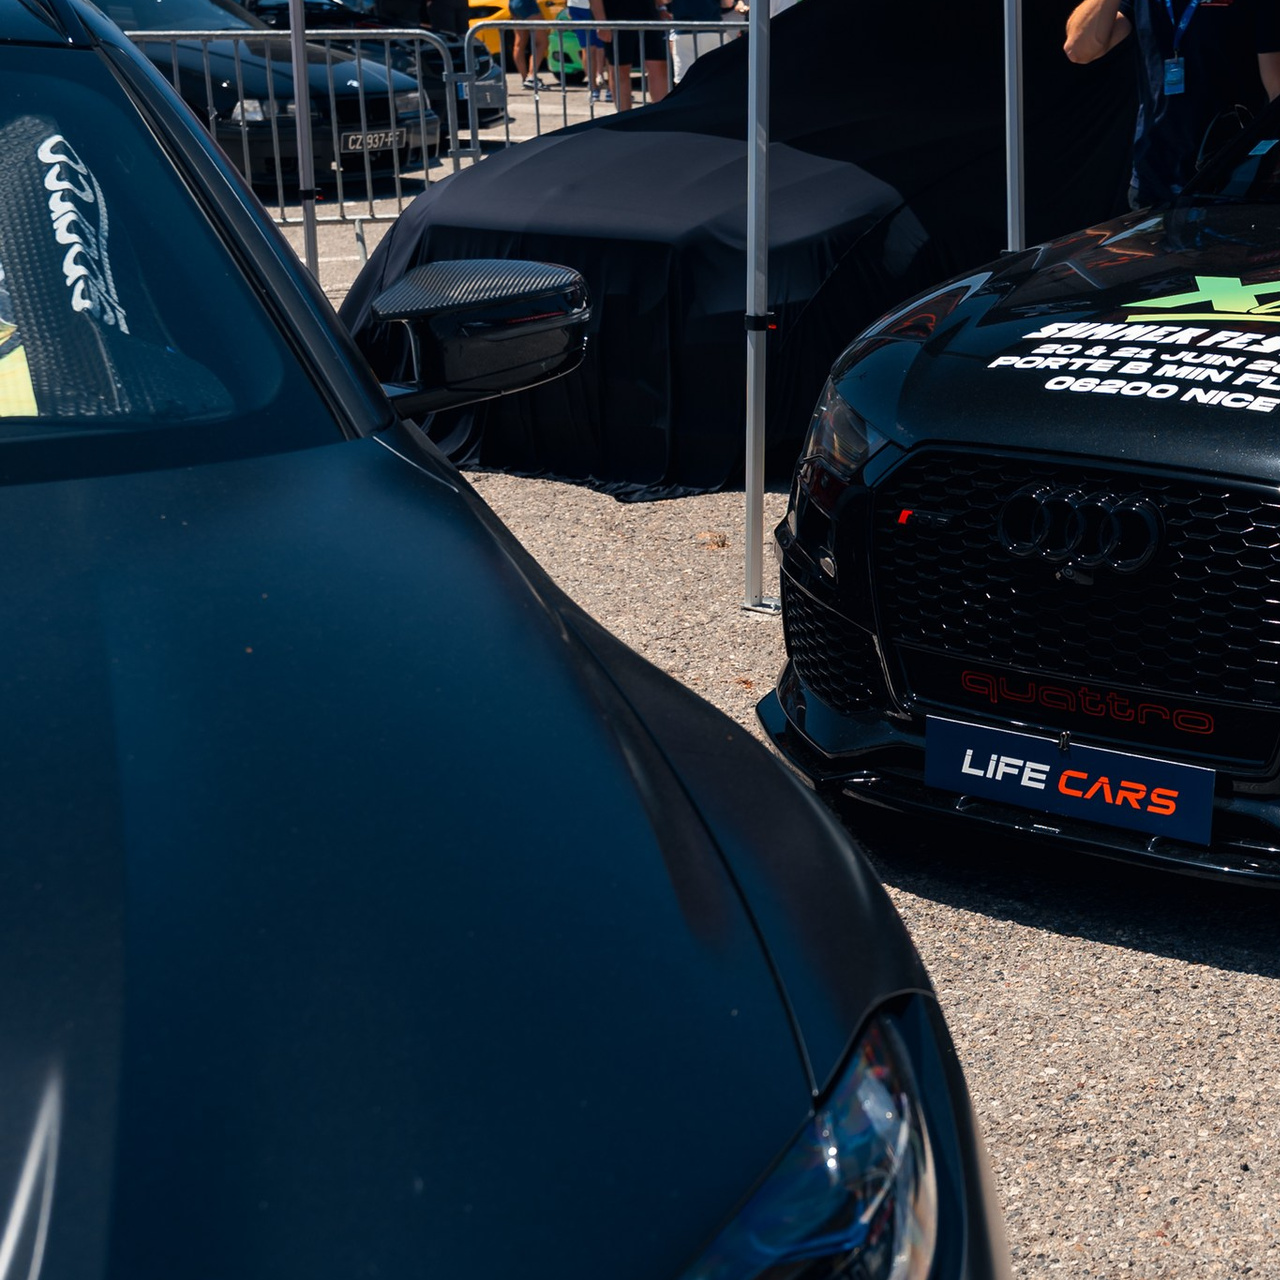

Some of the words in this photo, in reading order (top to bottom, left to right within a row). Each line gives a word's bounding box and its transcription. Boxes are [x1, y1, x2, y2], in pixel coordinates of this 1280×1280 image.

[1021, 322, 1201, 347] SUMMER
[1030, 343, 1078, 355] 20
[1110, 347, 1154, 360] 21
[1159, 349, 1242, 368] JUIN
[987, 356, 1118, 373] PORTE
[1118, 361, 1153, 375] B
[1153, 364, 1234, 384] MIN
[1044, 376, 1179, 400] 06200
[962, 670, 1214, 734] quattro
[961, 749, 1050, 790] LIFE
[1057, 769, 1179, 816] CARS
